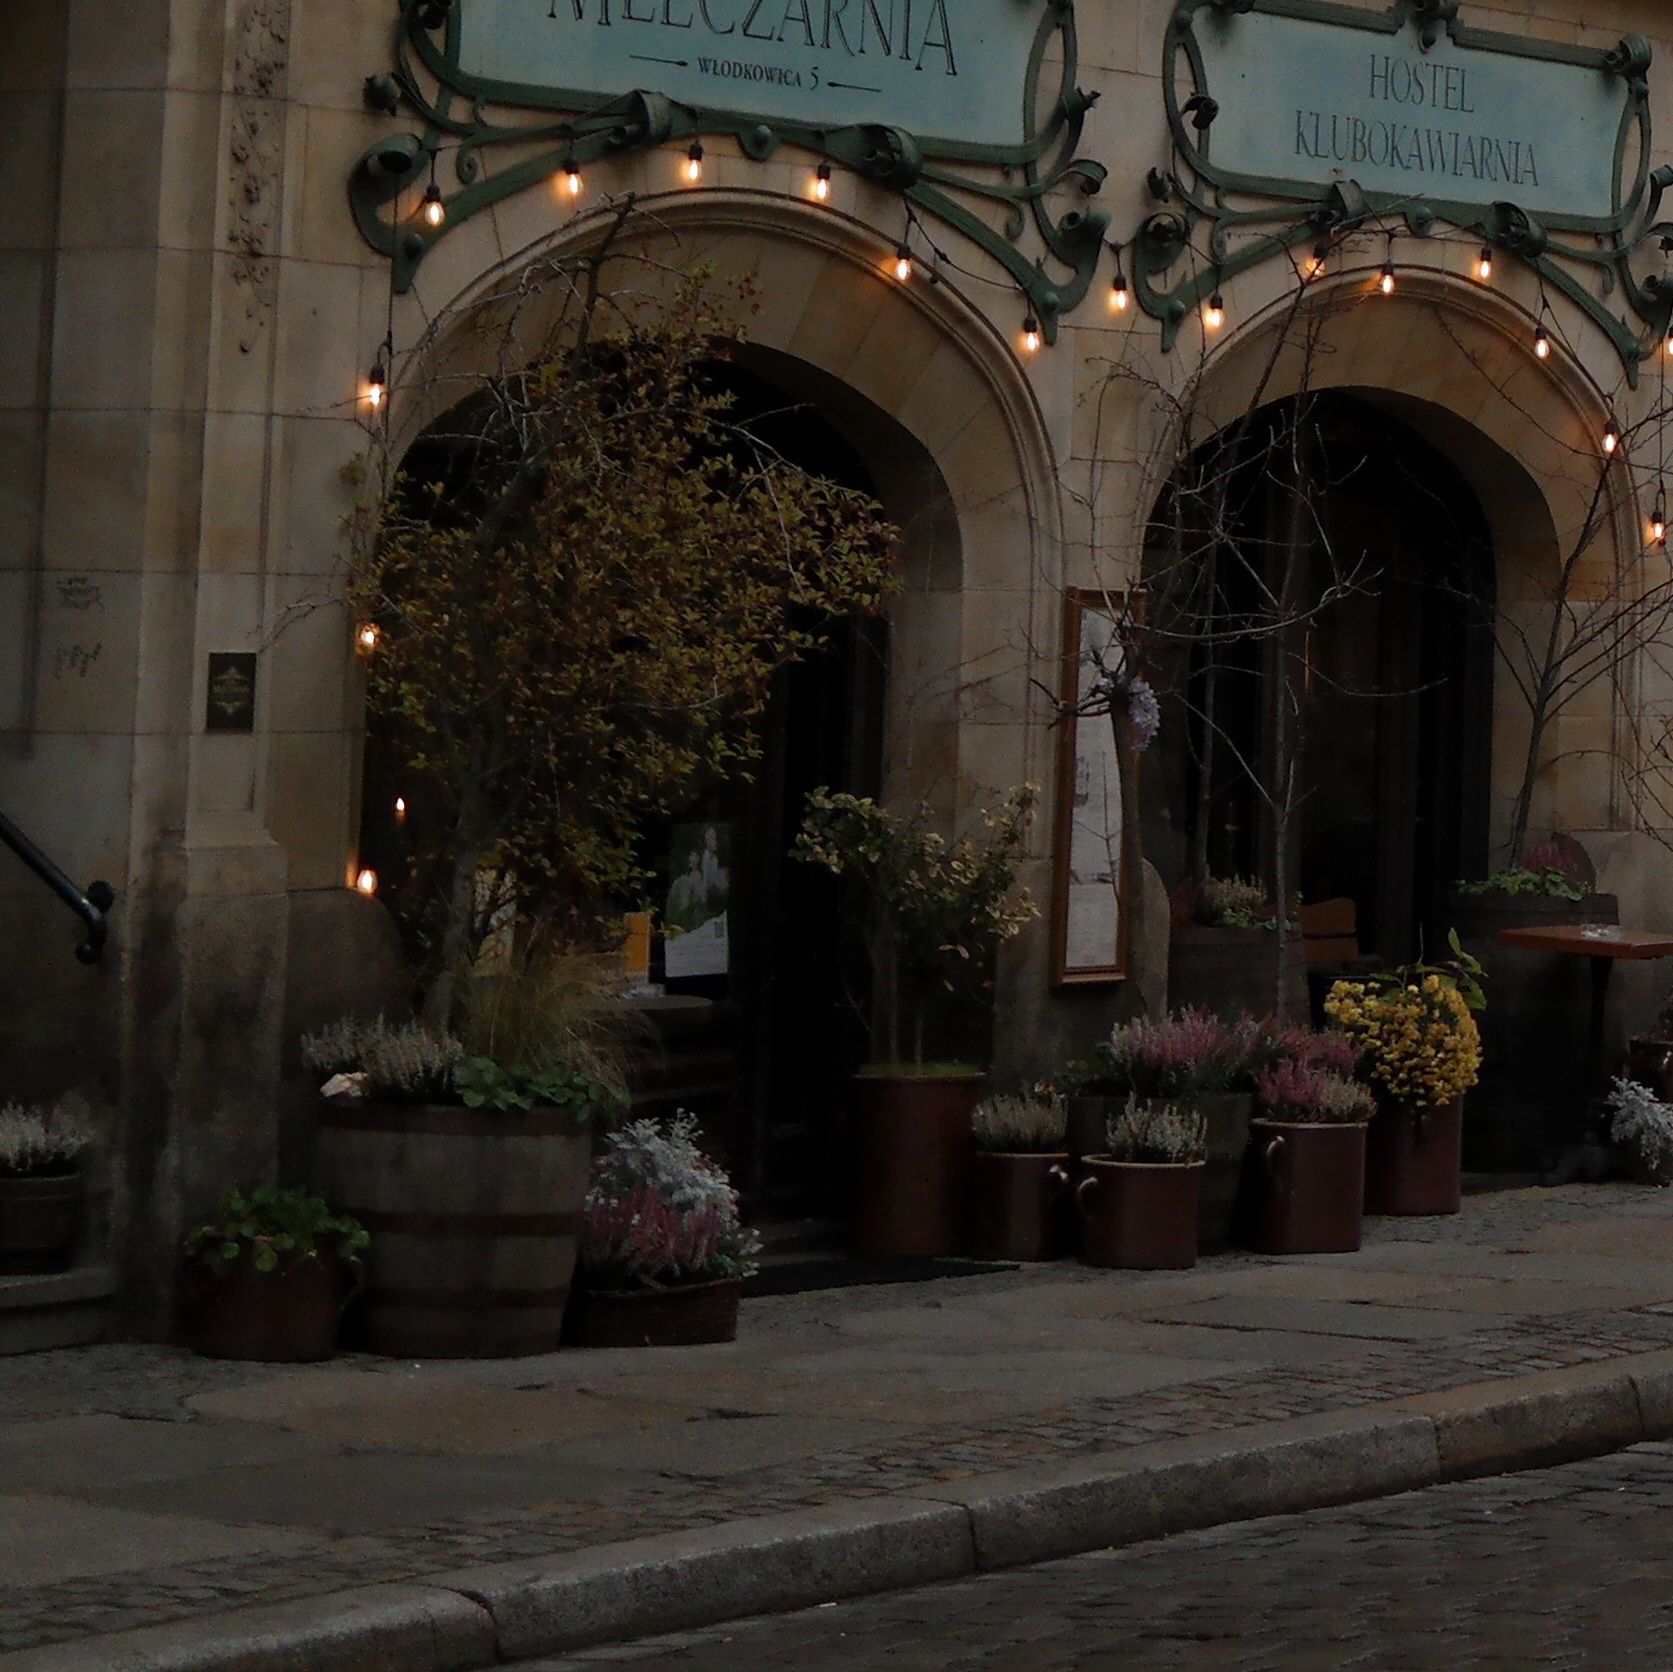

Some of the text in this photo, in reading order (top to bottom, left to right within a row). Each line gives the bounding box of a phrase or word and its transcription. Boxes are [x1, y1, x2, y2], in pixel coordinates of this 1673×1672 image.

[697, 56, 820, 90] WŁODKOWICA 5
[1369, 54, 1475, 113] HOSTEL
[1294, 110, 1539, 186] KLUBOKAWIARNIA
